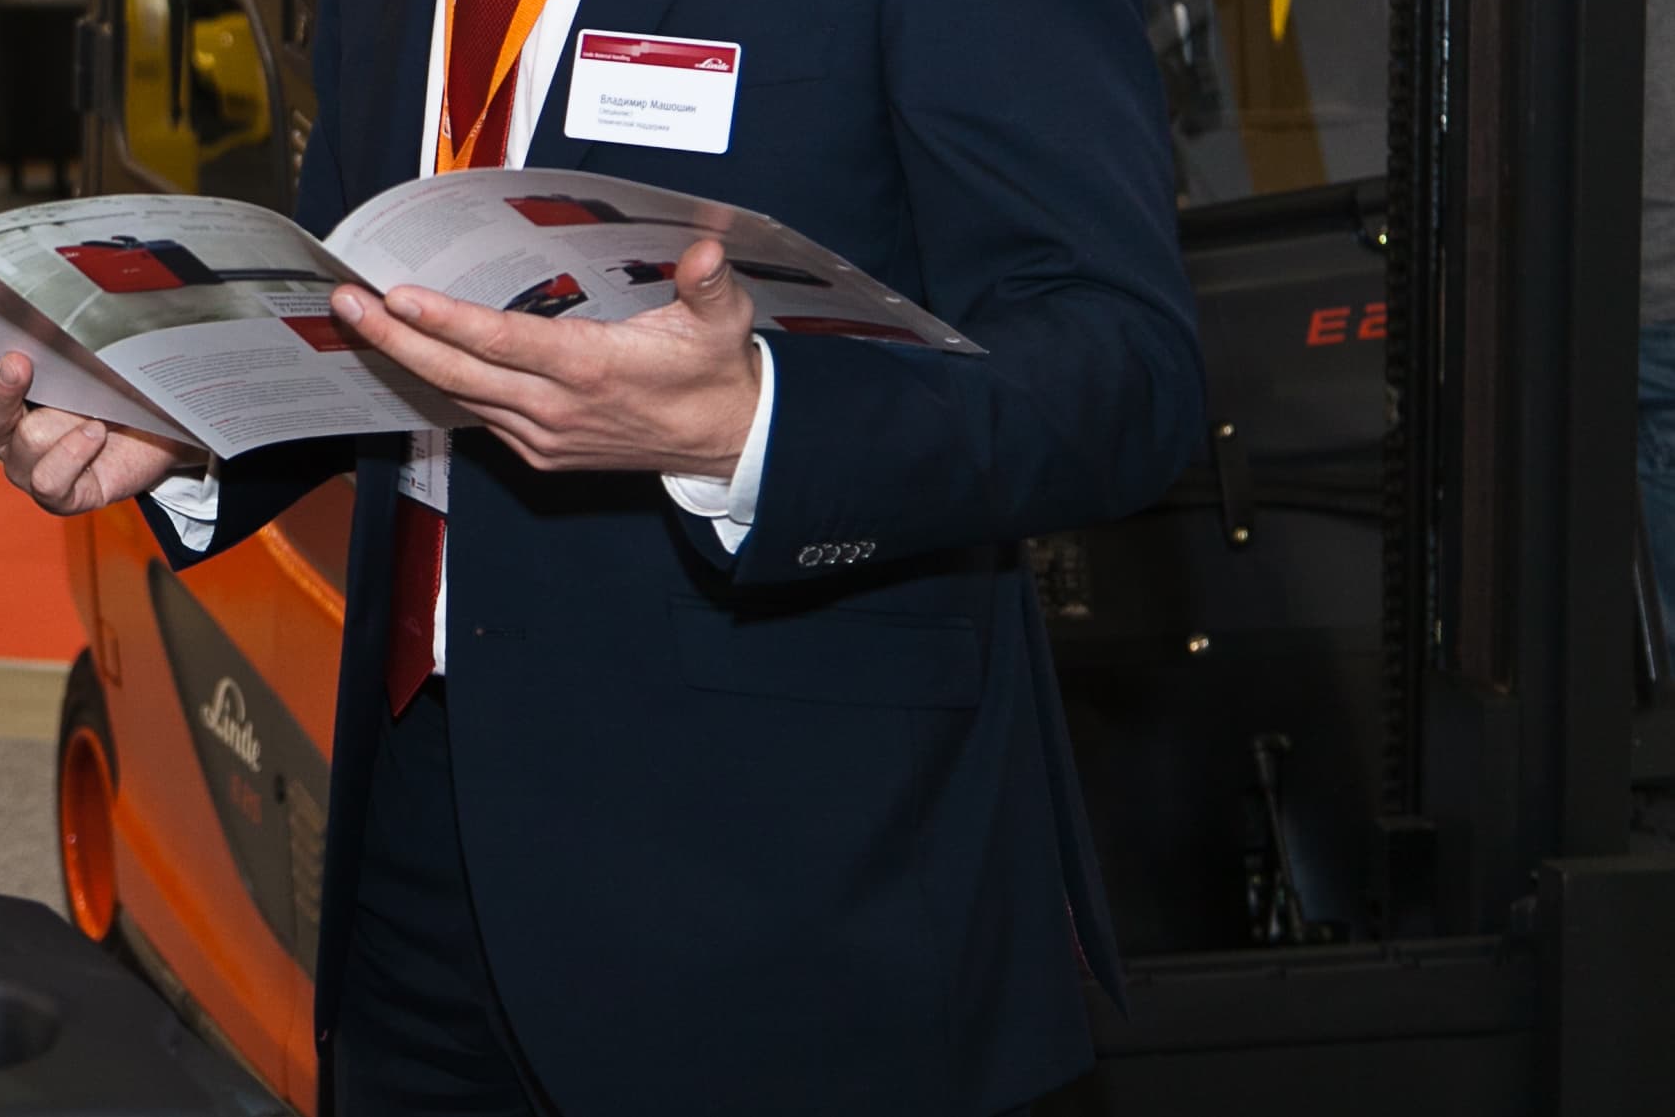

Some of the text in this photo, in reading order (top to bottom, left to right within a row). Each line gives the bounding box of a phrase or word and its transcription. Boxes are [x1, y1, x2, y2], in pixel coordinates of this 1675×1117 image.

[600, 94, 696, 112] Владимир Машошин
[201, 678, 261, 771] Linde
